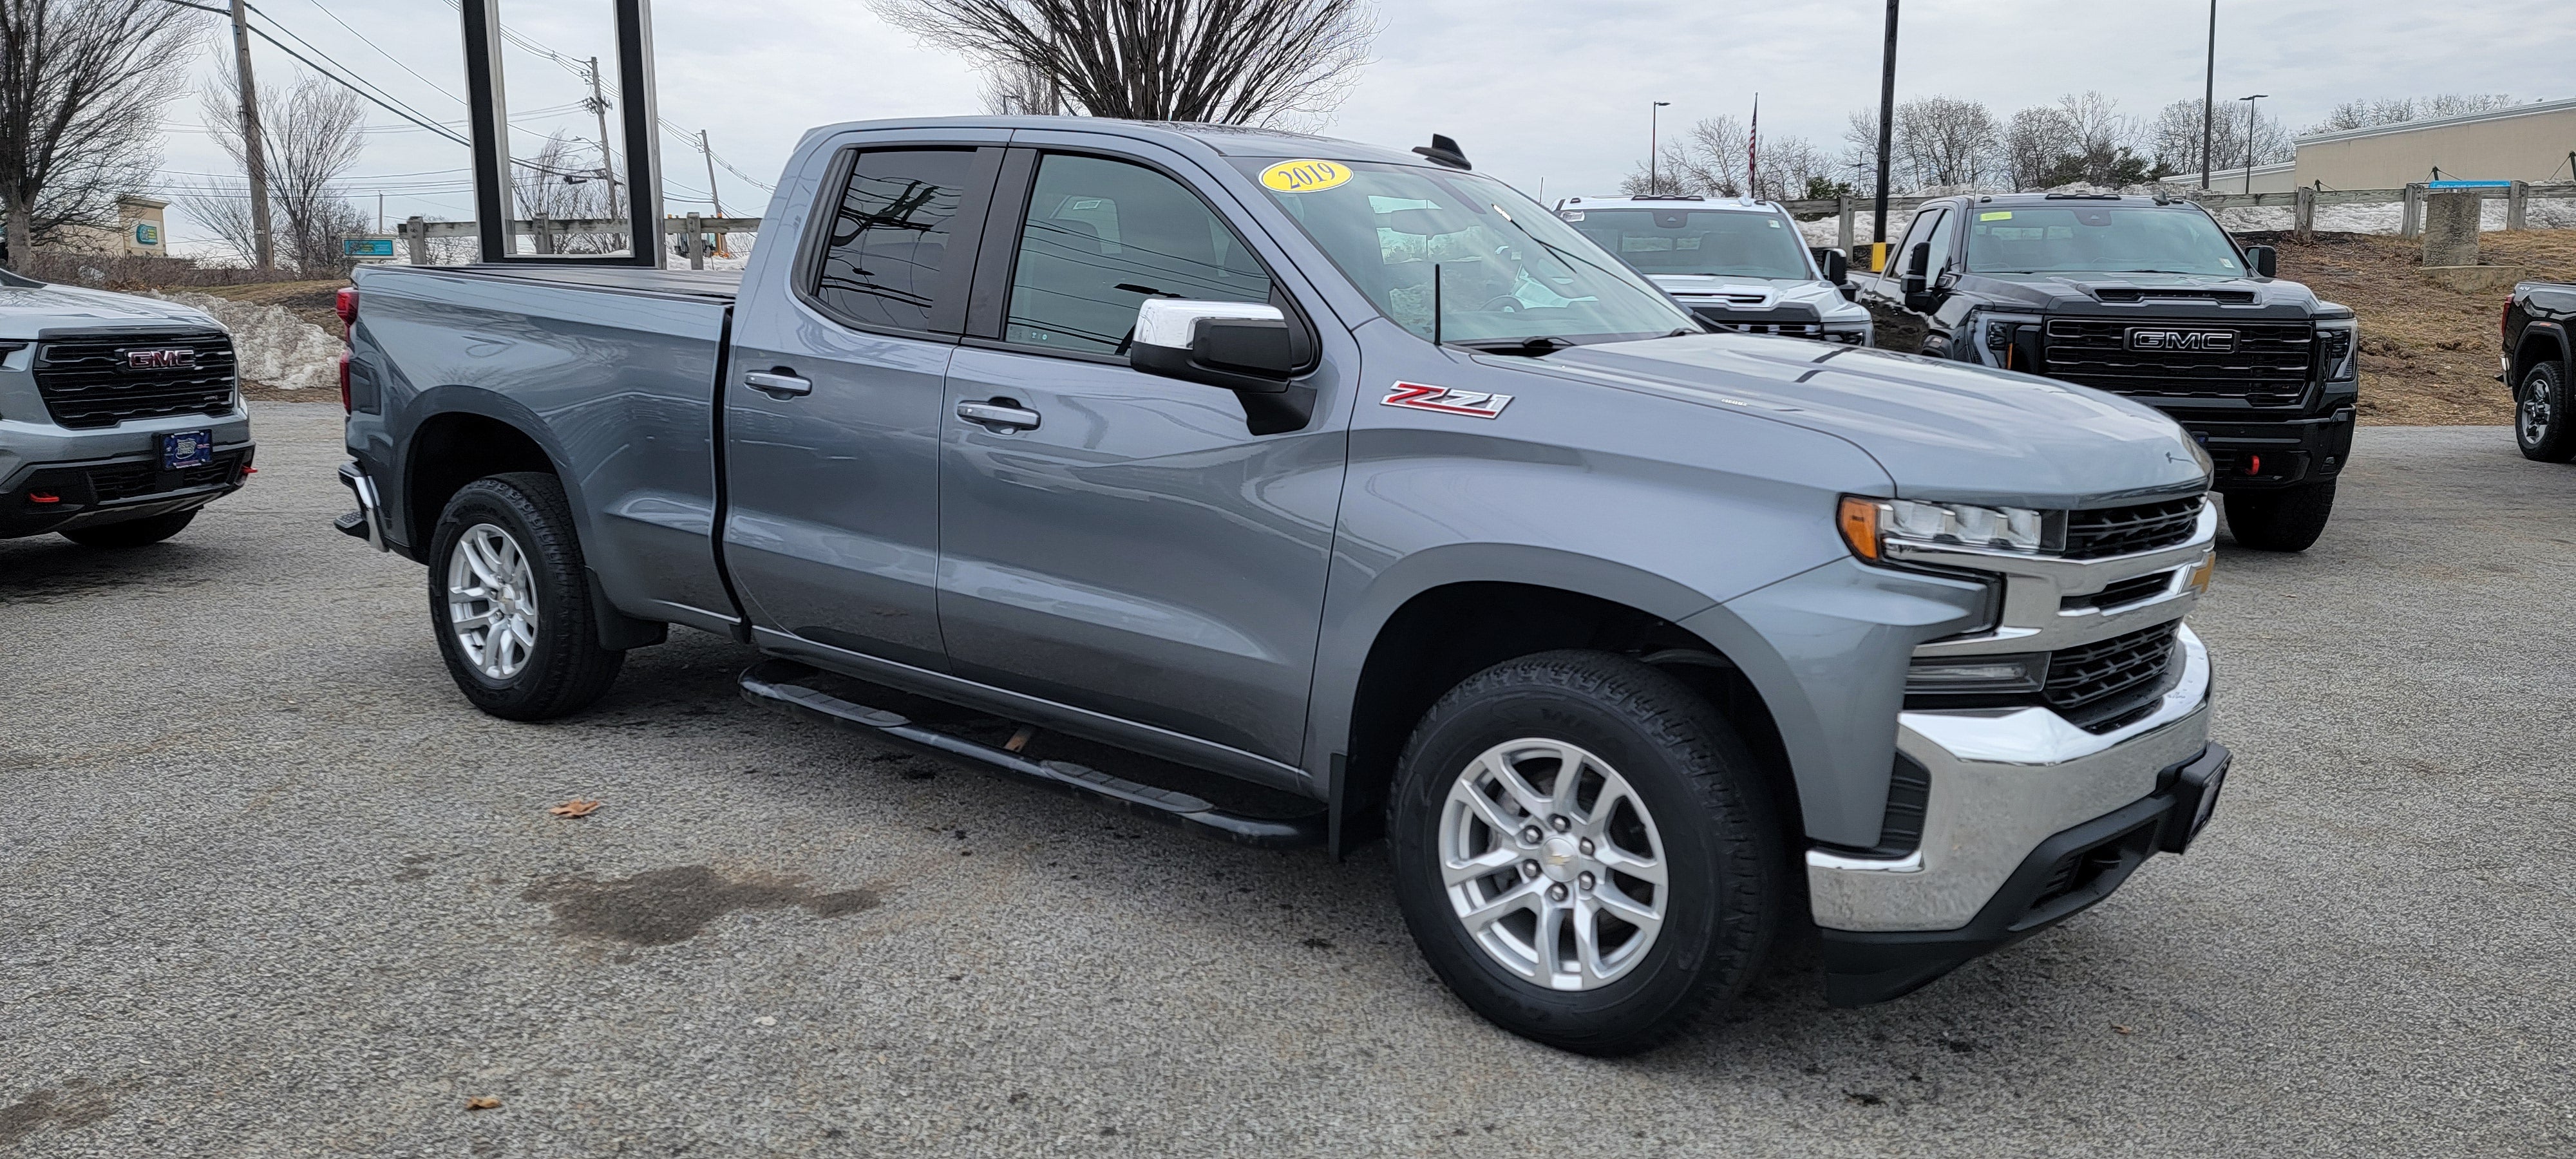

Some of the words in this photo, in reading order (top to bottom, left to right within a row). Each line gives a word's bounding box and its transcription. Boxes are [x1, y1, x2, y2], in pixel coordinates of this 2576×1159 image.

[1278, 162, 1335, 189] 2019
[2134, 331, 2232, 350] GMC
[128, 350, 196, 368] GMC
[1379, 379, 1515, 420] Z71
